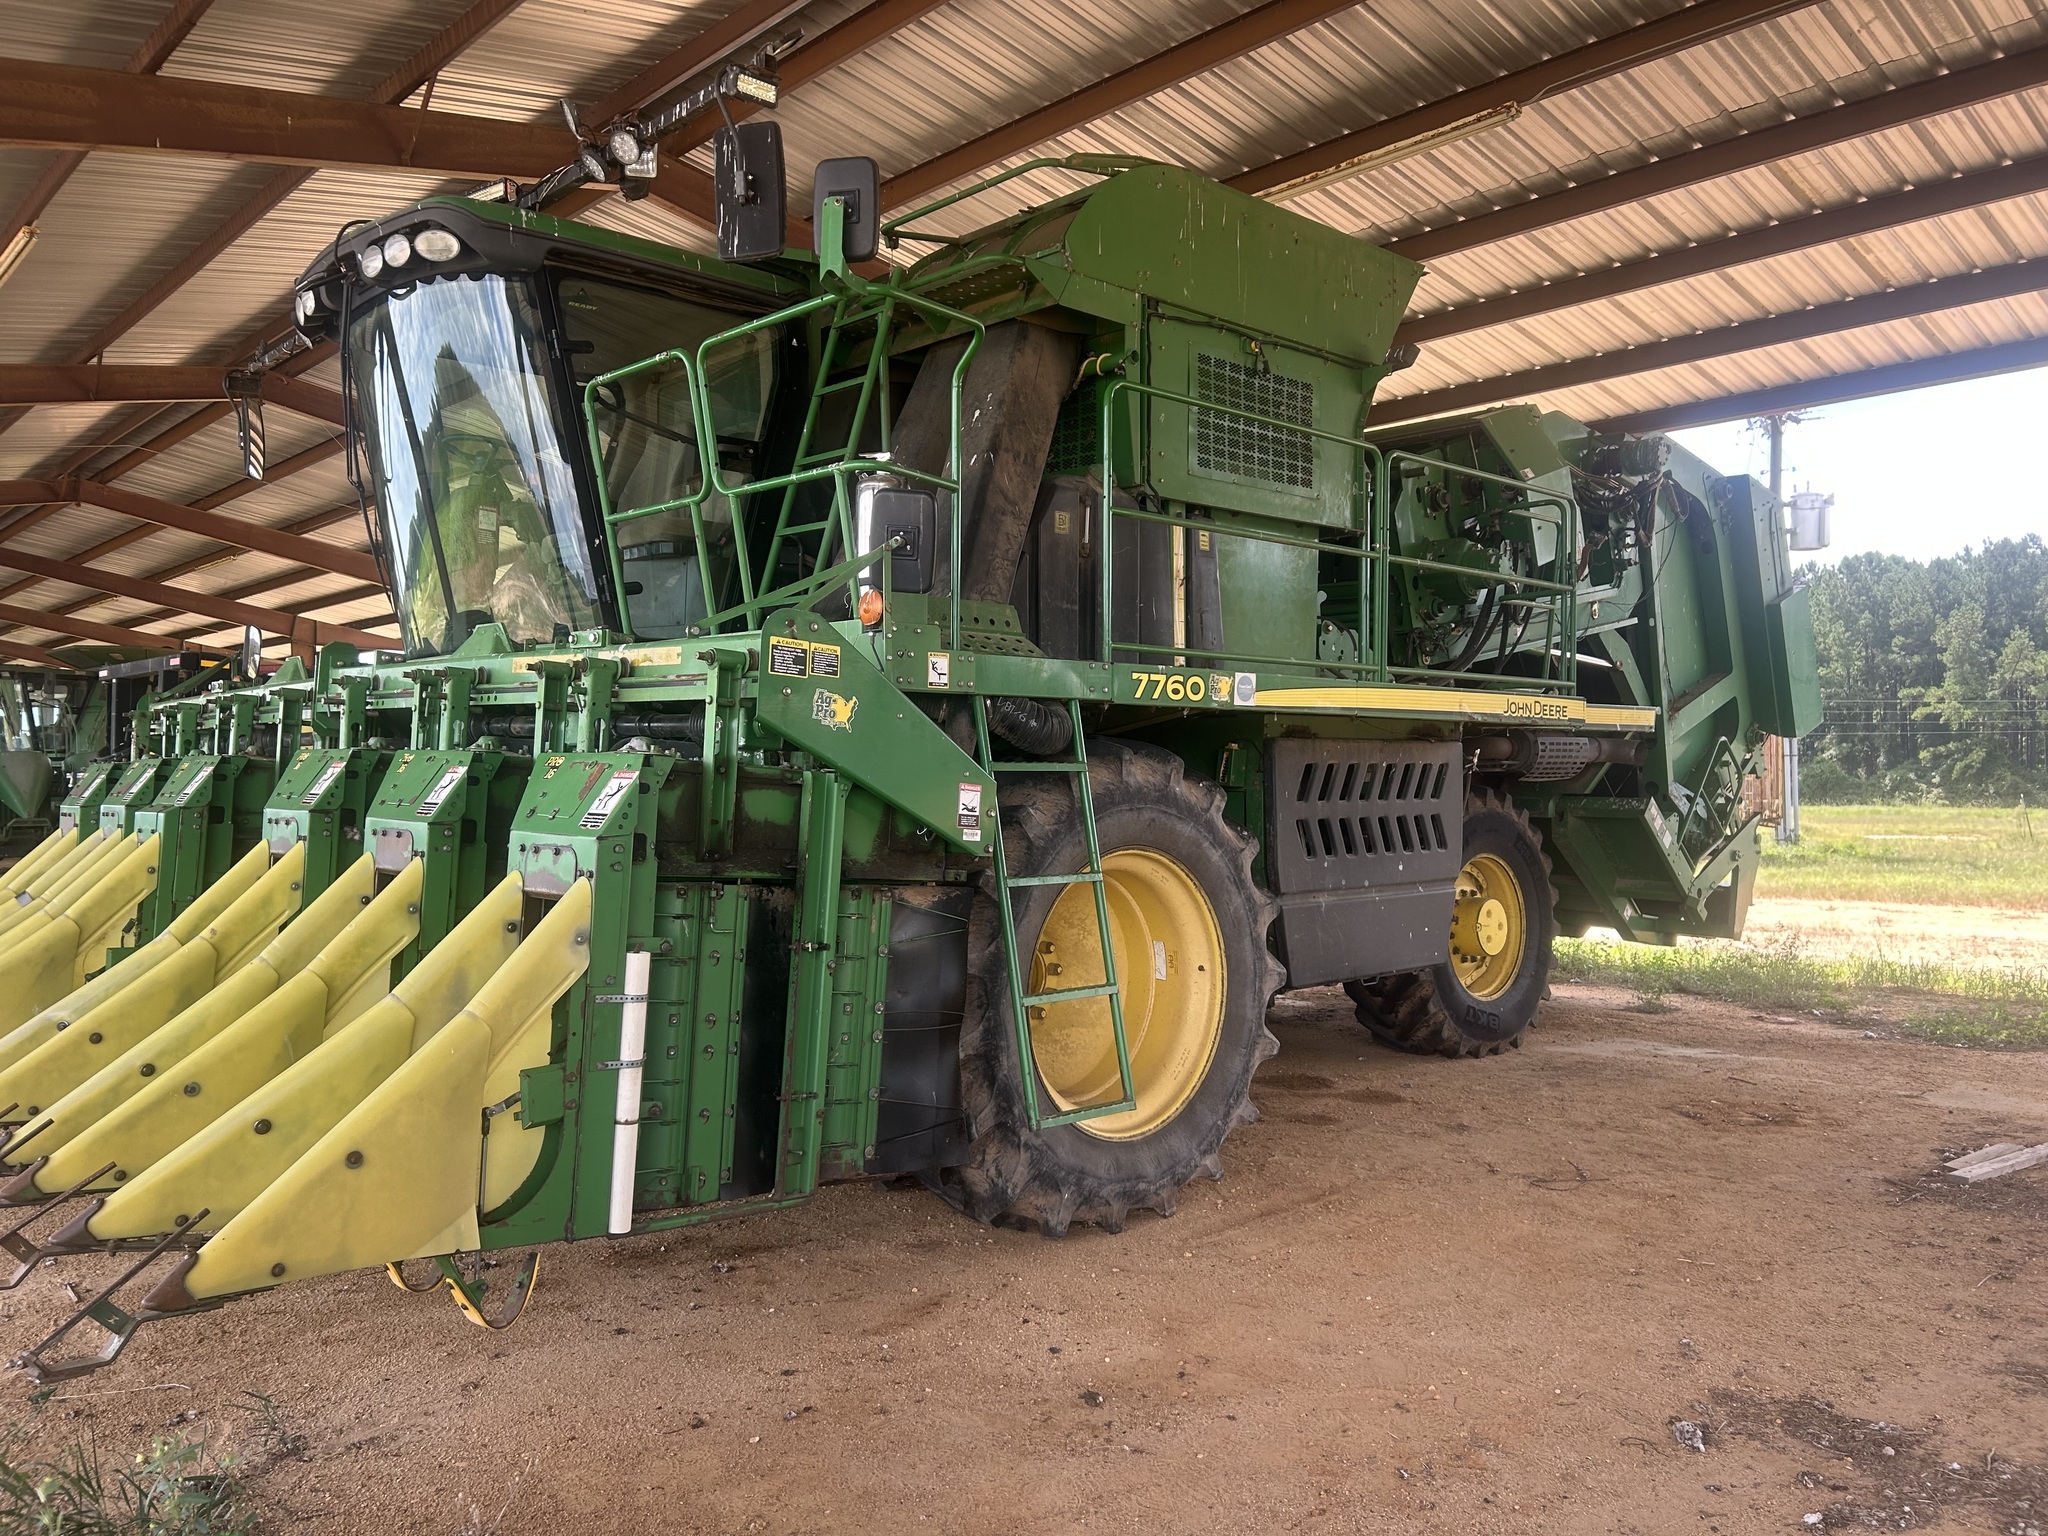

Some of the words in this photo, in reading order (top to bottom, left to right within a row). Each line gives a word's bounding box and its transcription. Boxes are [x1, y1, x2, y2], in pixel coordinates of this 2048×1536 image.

[568, 301, 598, 310] READY
[782, 639, 804, 647] CAUTION
[817, 646, 838, 654] CAUTION
[1131, 671, 1206, 701] 7760
[815, 704, 836, 718] Pro
[1503, 698, 1532, 715] JOHN
[1534, 700, 1568, 718] DEERE
[1464, 1004, 1500, 1034] BKT
